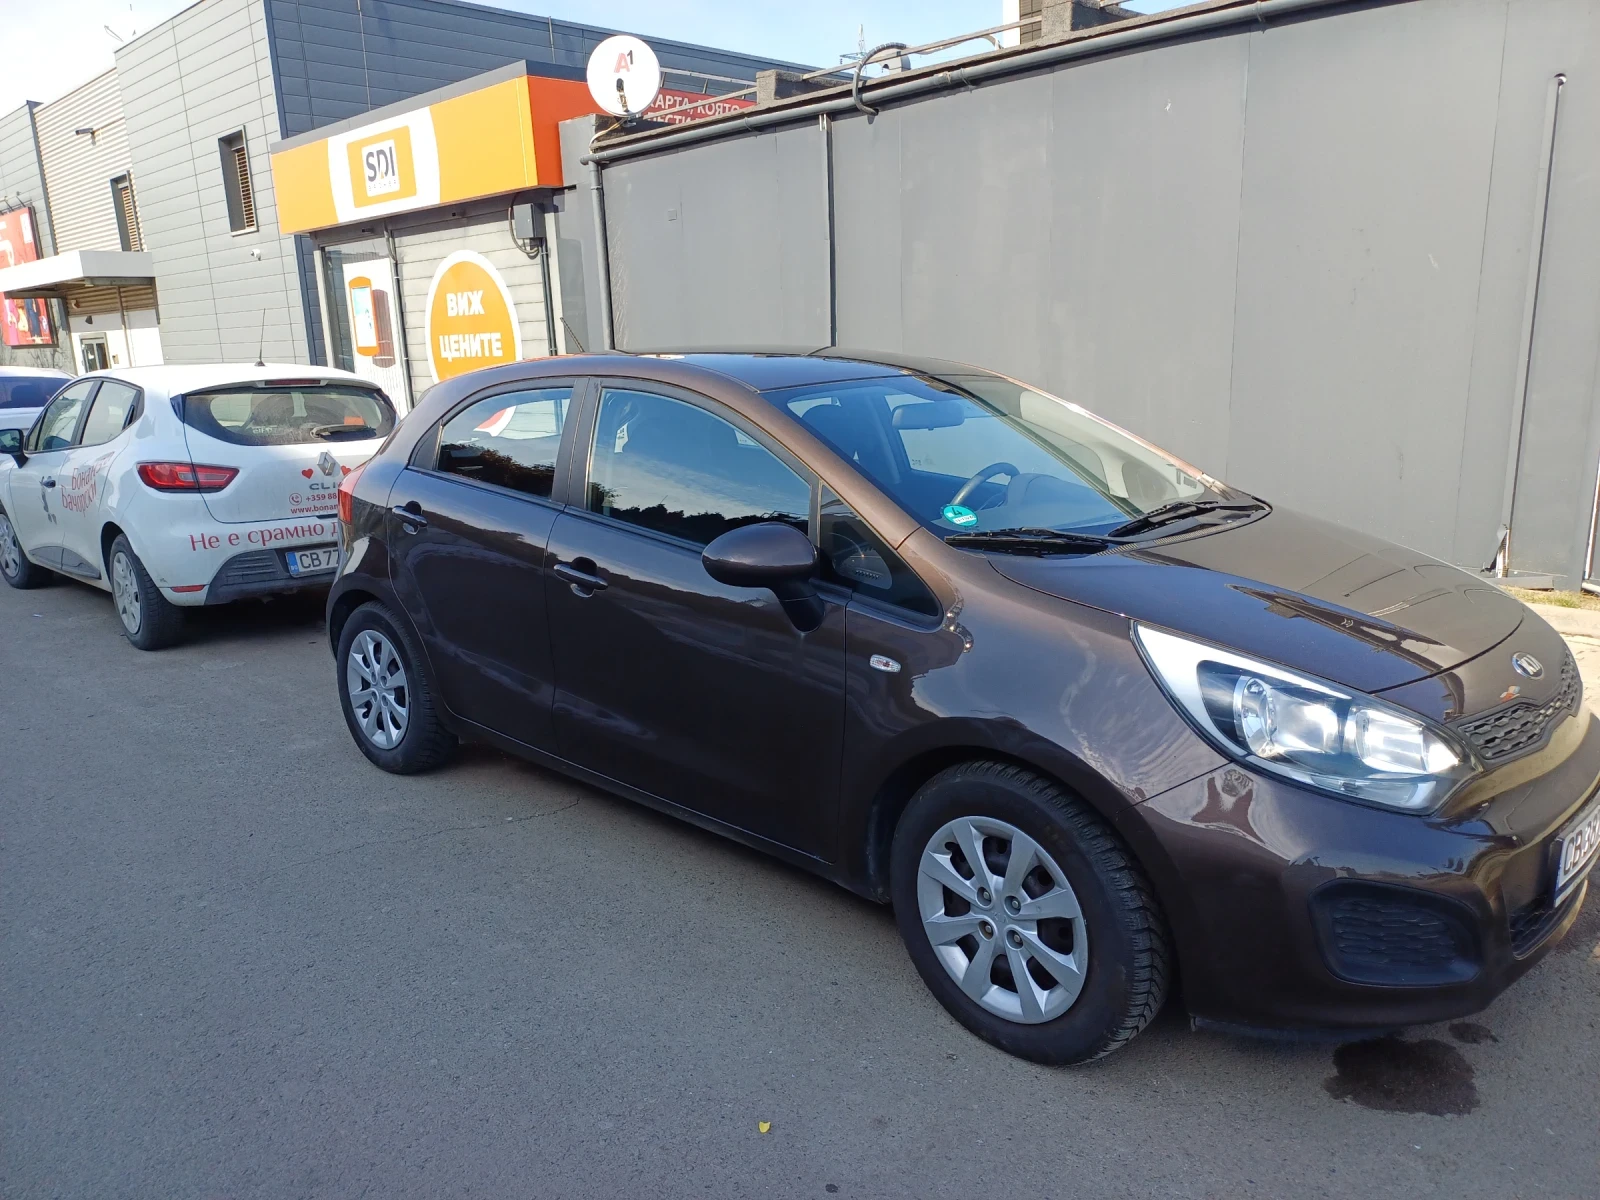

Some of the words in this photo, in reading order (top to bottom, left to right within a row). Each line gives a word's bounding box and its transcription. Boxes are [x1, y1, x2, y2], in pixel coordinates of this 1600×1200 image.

[613, 49, 633, 73] A1
[365, 146, 396, 182] SDI
[446, 290, 485, 317] ВИЖ
[439, 332, 503, 363] ЦЕНИТЕ
[306, 494, 326, 502] +359
[309, 482, 342, 490] CLI
[188, 532, 220, 551] Не
[228, 532, 240, 546] е
[247, 522, 325, 547] срамно
[299, 552, 322, 569] CB
